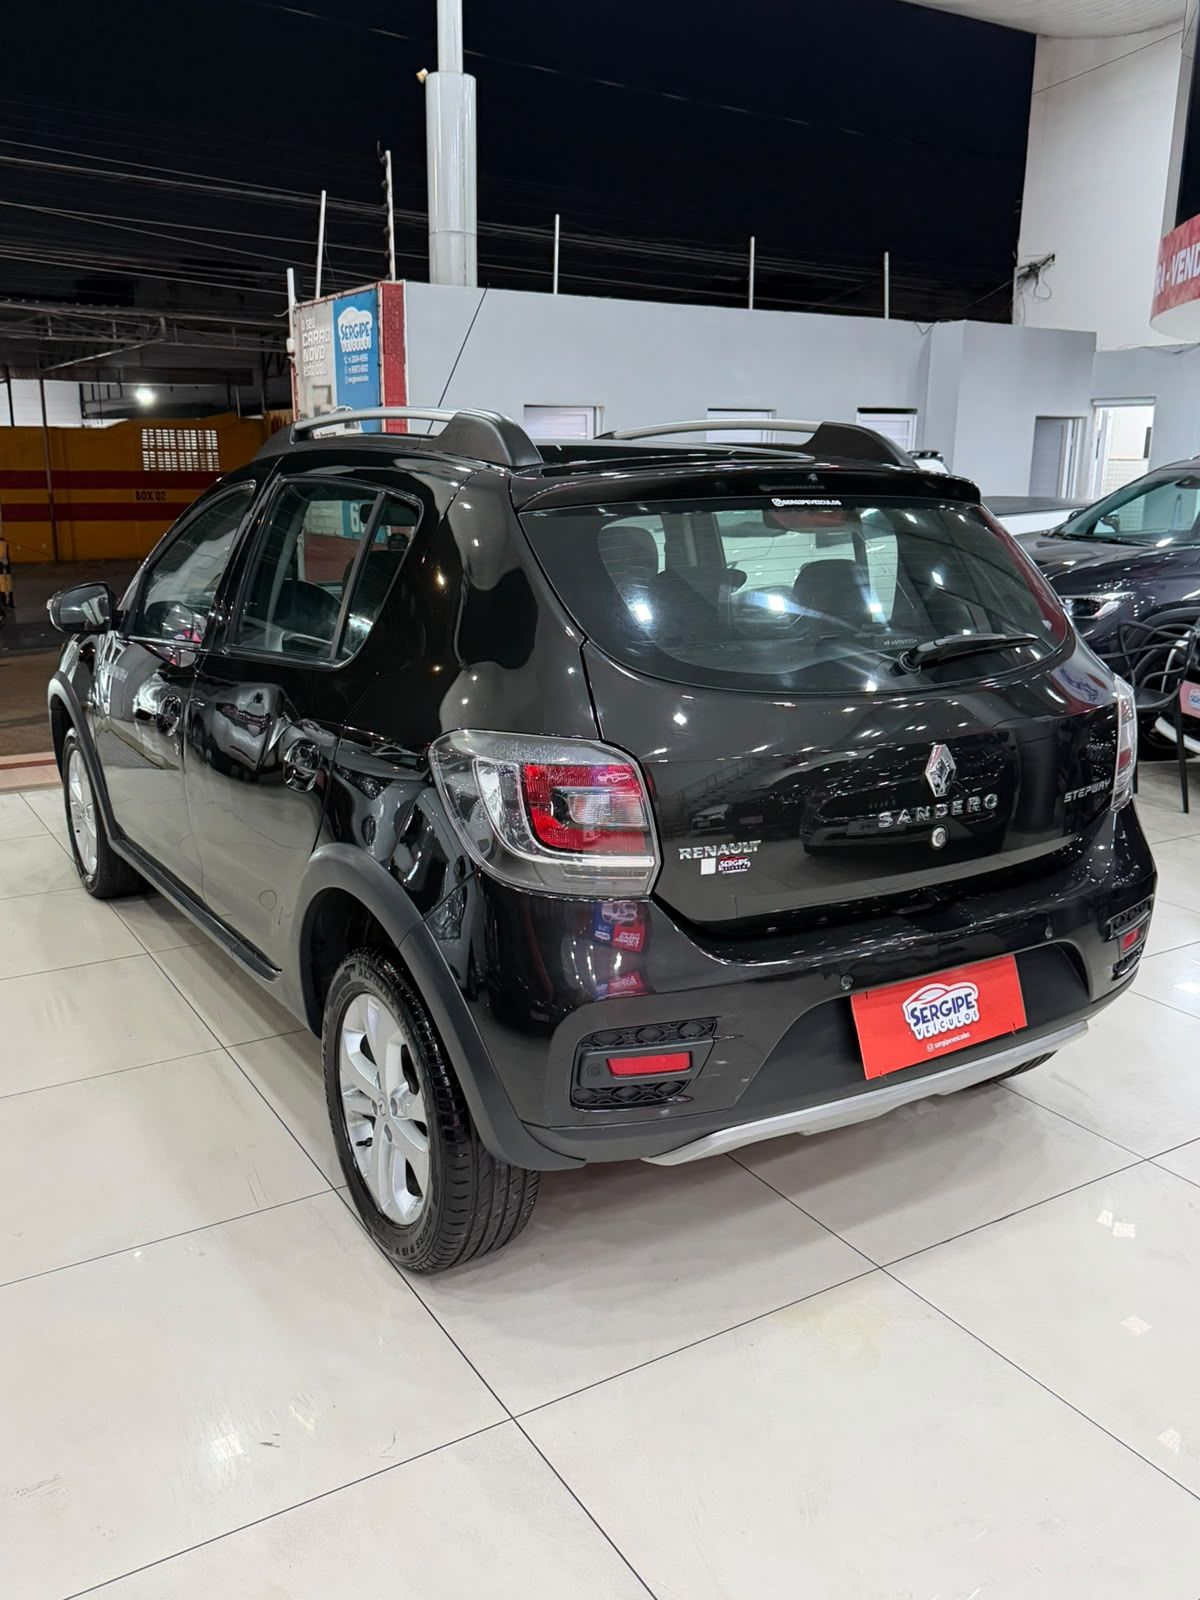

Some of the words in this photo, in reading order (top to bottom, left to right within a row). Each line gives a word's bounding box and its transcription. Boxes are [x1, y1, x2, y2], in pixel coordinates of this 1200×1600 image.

[340, 322, 370, 340] SERGIPE
[304, 345, 325, 362] NOVO
[136, 490, 154, 501] BOX
[156, 490, 167, 501] 02
[1063, 778, 1112, 804] STEPWAY
[878, 793, 999, 828] SANDERO
[678, 840, 762, 860] RENAULT
[910, 992, 975, 1027] SERGIPE
[916, 1010, 978, 1036] VEÍCULOS
